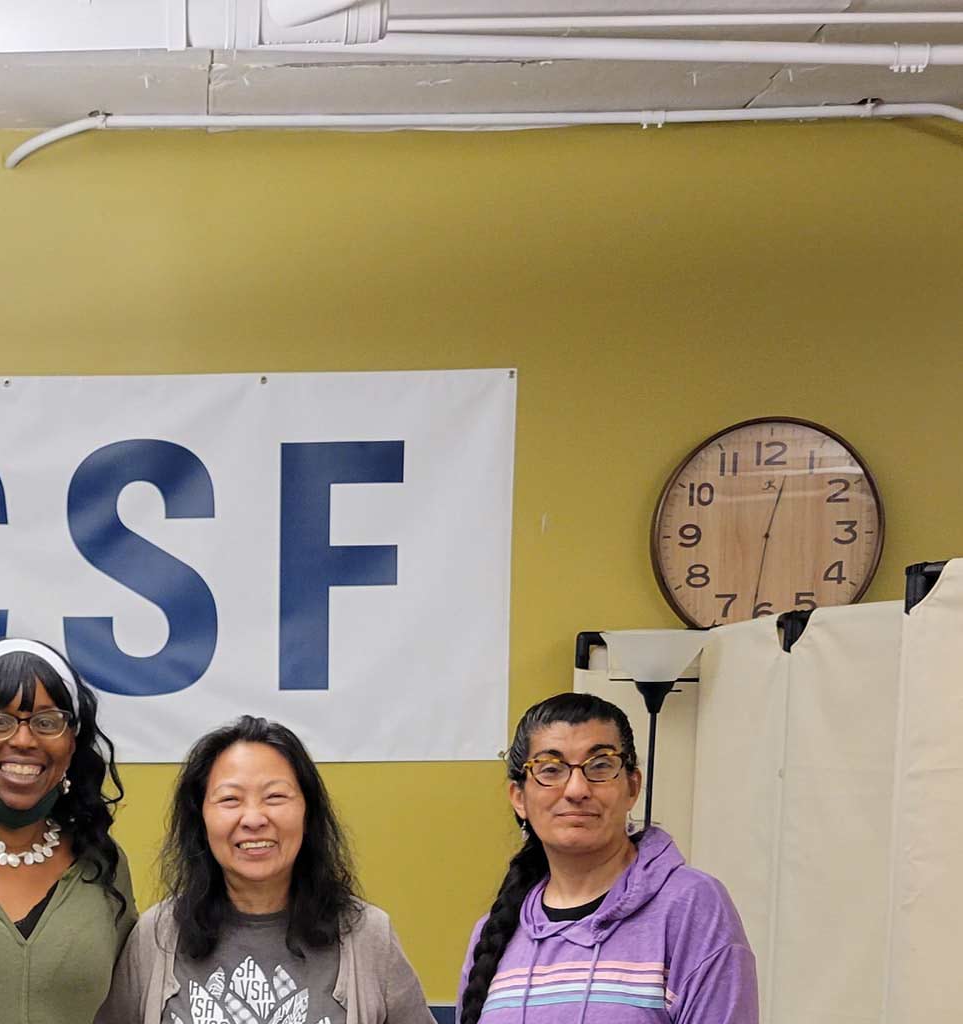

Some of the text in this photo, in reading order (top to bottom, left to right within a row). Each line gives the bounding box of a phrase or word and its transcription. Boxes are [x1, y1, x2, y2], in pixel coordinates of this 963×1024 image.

[719, 451, 738, 477] 11
[755, 441, 788, 466] 12
[809, 450, 815, 475] 1
[688, 482, 714, 506] 10
[826, 478, 850, 503] 2
[678, 524, 702, 548] 9
[833, 520, 858, 545] 3
[685, 564, 710, 588] 8
[823, 560, 847, 585] 4
[715, 593, 737, 618] 7
[795, 592, 817, 611] 5
[240, 980, 270, 1001] VSA
